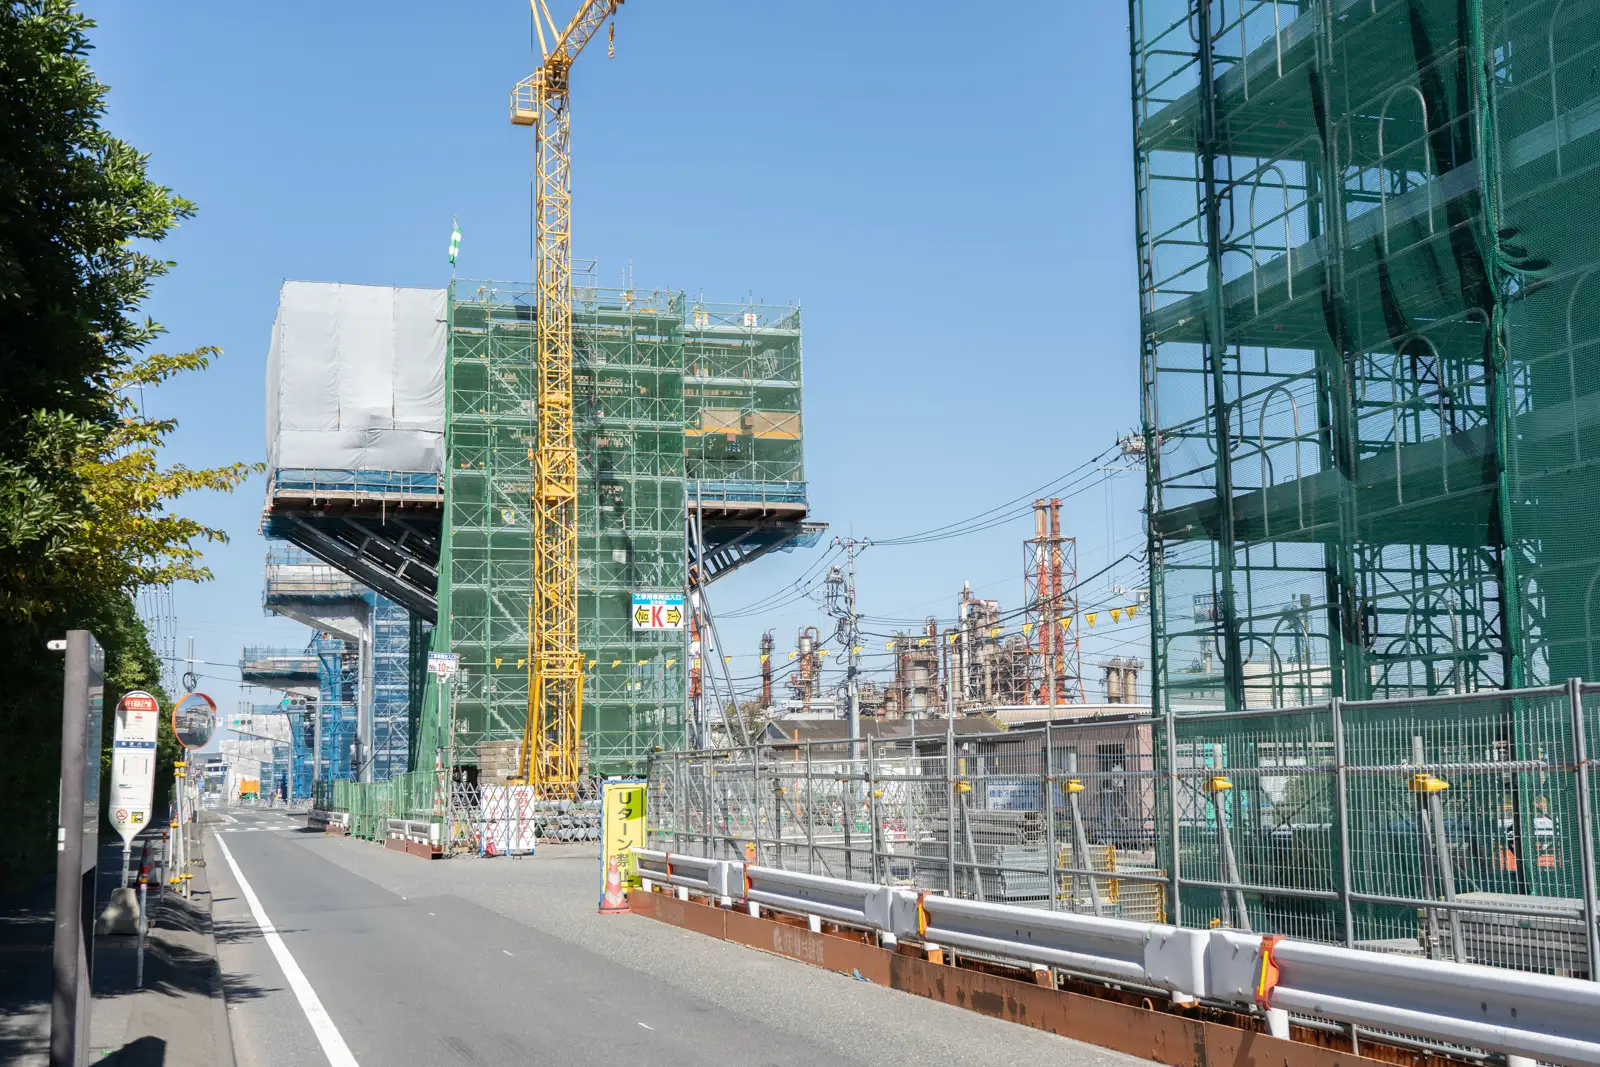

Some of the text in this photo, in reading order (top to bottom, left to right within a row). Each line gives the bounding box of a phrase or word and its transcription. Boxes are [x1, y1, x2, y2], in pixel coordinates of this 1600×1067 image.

[652, 605, 664, 627] K
[438, 662, 446, 672] 10
[617, 791, 634, 882] Uターン禁止
